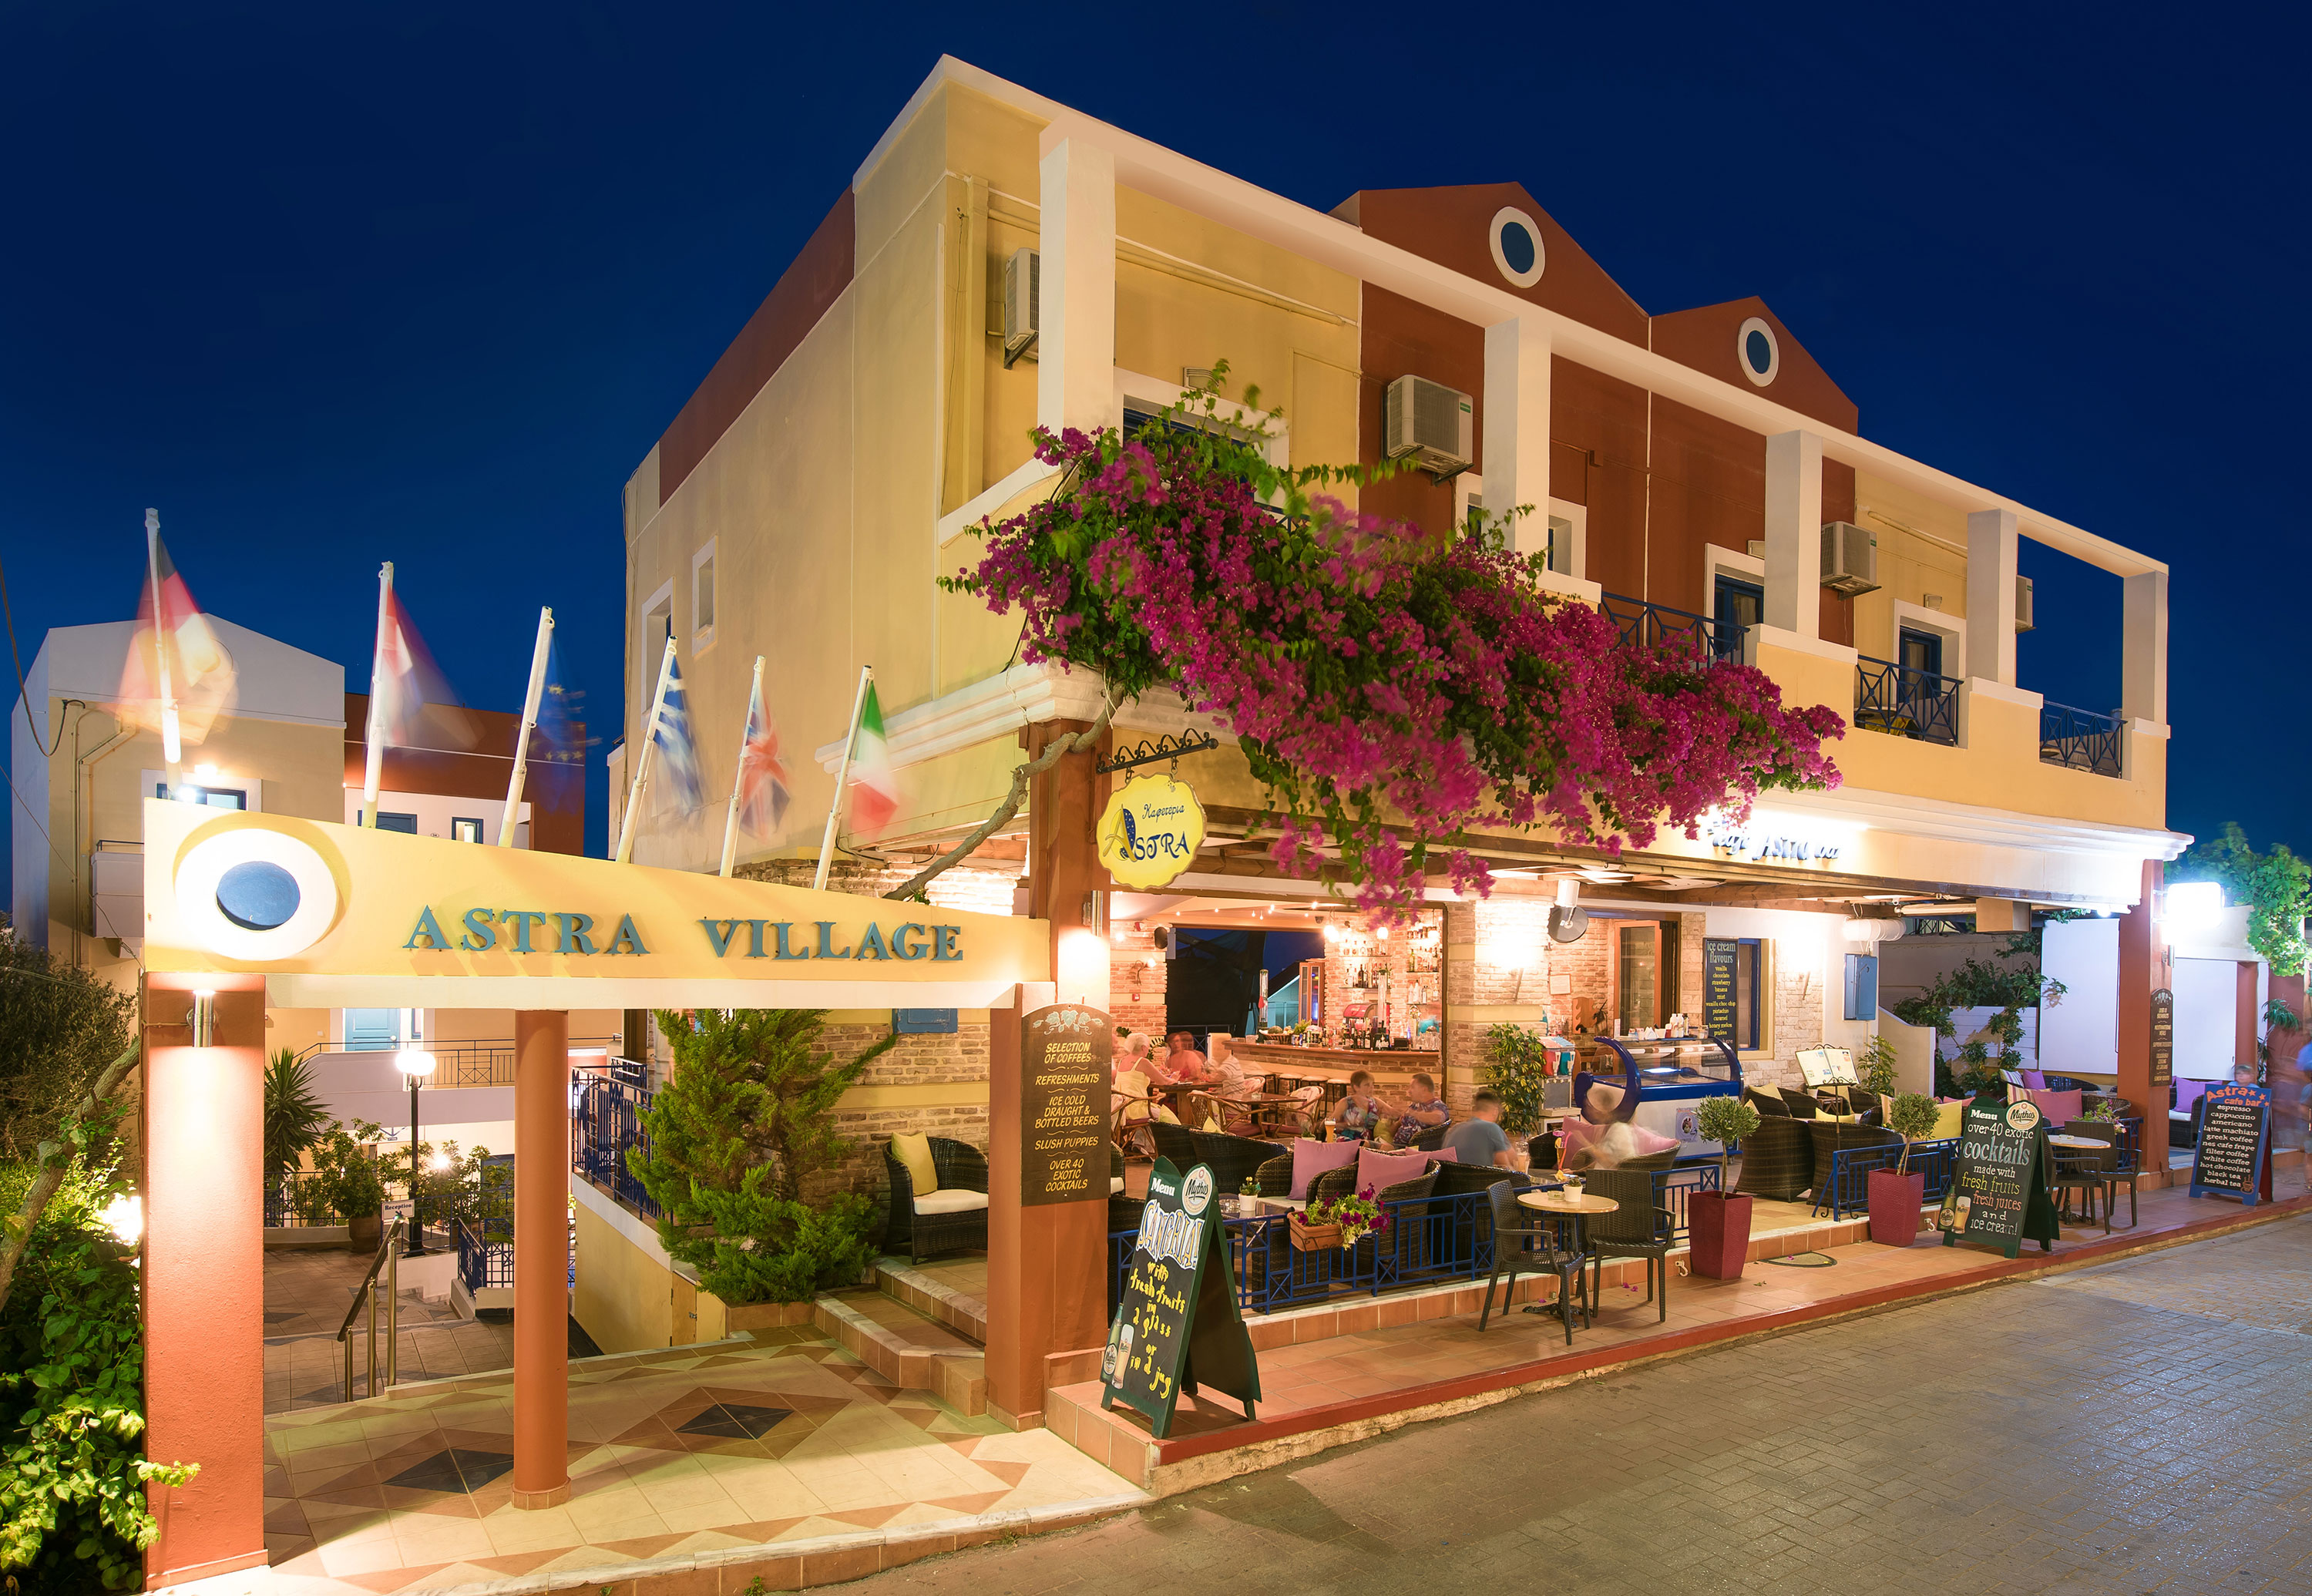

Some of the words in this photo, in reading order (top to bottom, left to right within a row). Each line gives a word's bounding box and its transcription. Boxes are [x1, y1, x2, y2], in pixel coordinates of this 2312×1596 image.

[1103, 805, 1189, 862] ASTRA
[402, 905, 652, 956] ASTRA
[701, 918, 964, 963] VILLAGE
[1707, 942, 1716, 951] ice
[1717, 942, 1736, 952] cream
[1710, 951, 1733, 963] flavours
[1046, 1042, 1090, 1053] SELECTION
[1044, 1053, 1056, 1063] OF
[1057, 1053, 1091, 1063] COFFEES
[1035, 1074, 1100, 1086] REFRESHMENTS
[2206, 1085, 2247, 1102] Astra
[1049, 1096, 1062, 1106] ICE
[1065, 1095, 1086, 1105] COLD
[2245, 1098, 2261, 1107] bar
[1044, 1106, 1082, 1117] DRAUGHT
[1084, 1106, 1090, 1115] &
[1971, 1109, 1998, 1120] Menu
[2216, 1104, 2251, 1113] espresso
[2010, 1109, 2035, 1122] Mythos
[2210, 1111, 2256, 1121] cappuccino
[1035, 1117, 1072, 1129] BOTTLED
[1073, 1115, 1099, 1126] BEERS
[2211, 1119, 2253, 1127] americano
[1968, 1124, 1989, 1134] over
[1990, 1123, 2003, 1136] 40
[2005, 1129, 2033, 1139] exotic
[2203, 1125, 2220, 1134] latte
[2222, 1127, 2259, 1137] machiato
[1035, 1139, 1063, 1150] SLUSH
[1064, 1137, 1098, 1147] PUPPIES
[2206, 1134, 2228, 1142] greek
[2230, 1135, 2253, 1144] coffee
[1963, 1136, 2030, 1166] cocktails
[2234, 1143, 2255, 1152] frape
[1050, 1160, 1070, 1170] OVER
[1073, 1158, 1084, 1168] 40
[2203, 1155, 2225, 1164] white
[2226, 1158, 2250, 1166] coffee
[1054, 1169, 1081, 1181] EXOTIC
[1974, 1164, 1995, 1176] made
[1996, 1166, 2015, 1178] with
[2207, 1170, 2226, 1178] black
[2214, 1164, 2250, 1174] chocolate
[1046, 1179, 1088, 1192] COCKTAILS
[1151, 1178, 1174, 1196] Menu
[1961, 1172, 1988, 1191] fresh
[1991, 1176, 2020, 1194] fruits
[2204, 1177, 2228, 1186] herbal
[2230, 1179, 2241, 1188] tea
[1185, 1179, 1208, 1200] Mythos
[1973, 1190, 1994, 1207] fresh
[1994, 1194, 2021, 1211] juices
[1982, 1210, 2007, 1221] and
[1970, 1218, 1984, 1230] ice
[1136, 1199, 1205, 1270] SANGRIA!
[1148, 1261, 1169, 1282] with
[1131, 1268, 1155, 1299] fresh
[1156, 1285, 1185, 1315] fruits
[1133, 1307, 1139, 1326] a
[1141, 1315, 1171, 1339] glass
[1146, 1343, 1157, 1357] or
[1129, 1355, 1141, 1370] in
[1144, 1356, 1152, 1376] a
[1149, 1367, 1171, 1399] jug
